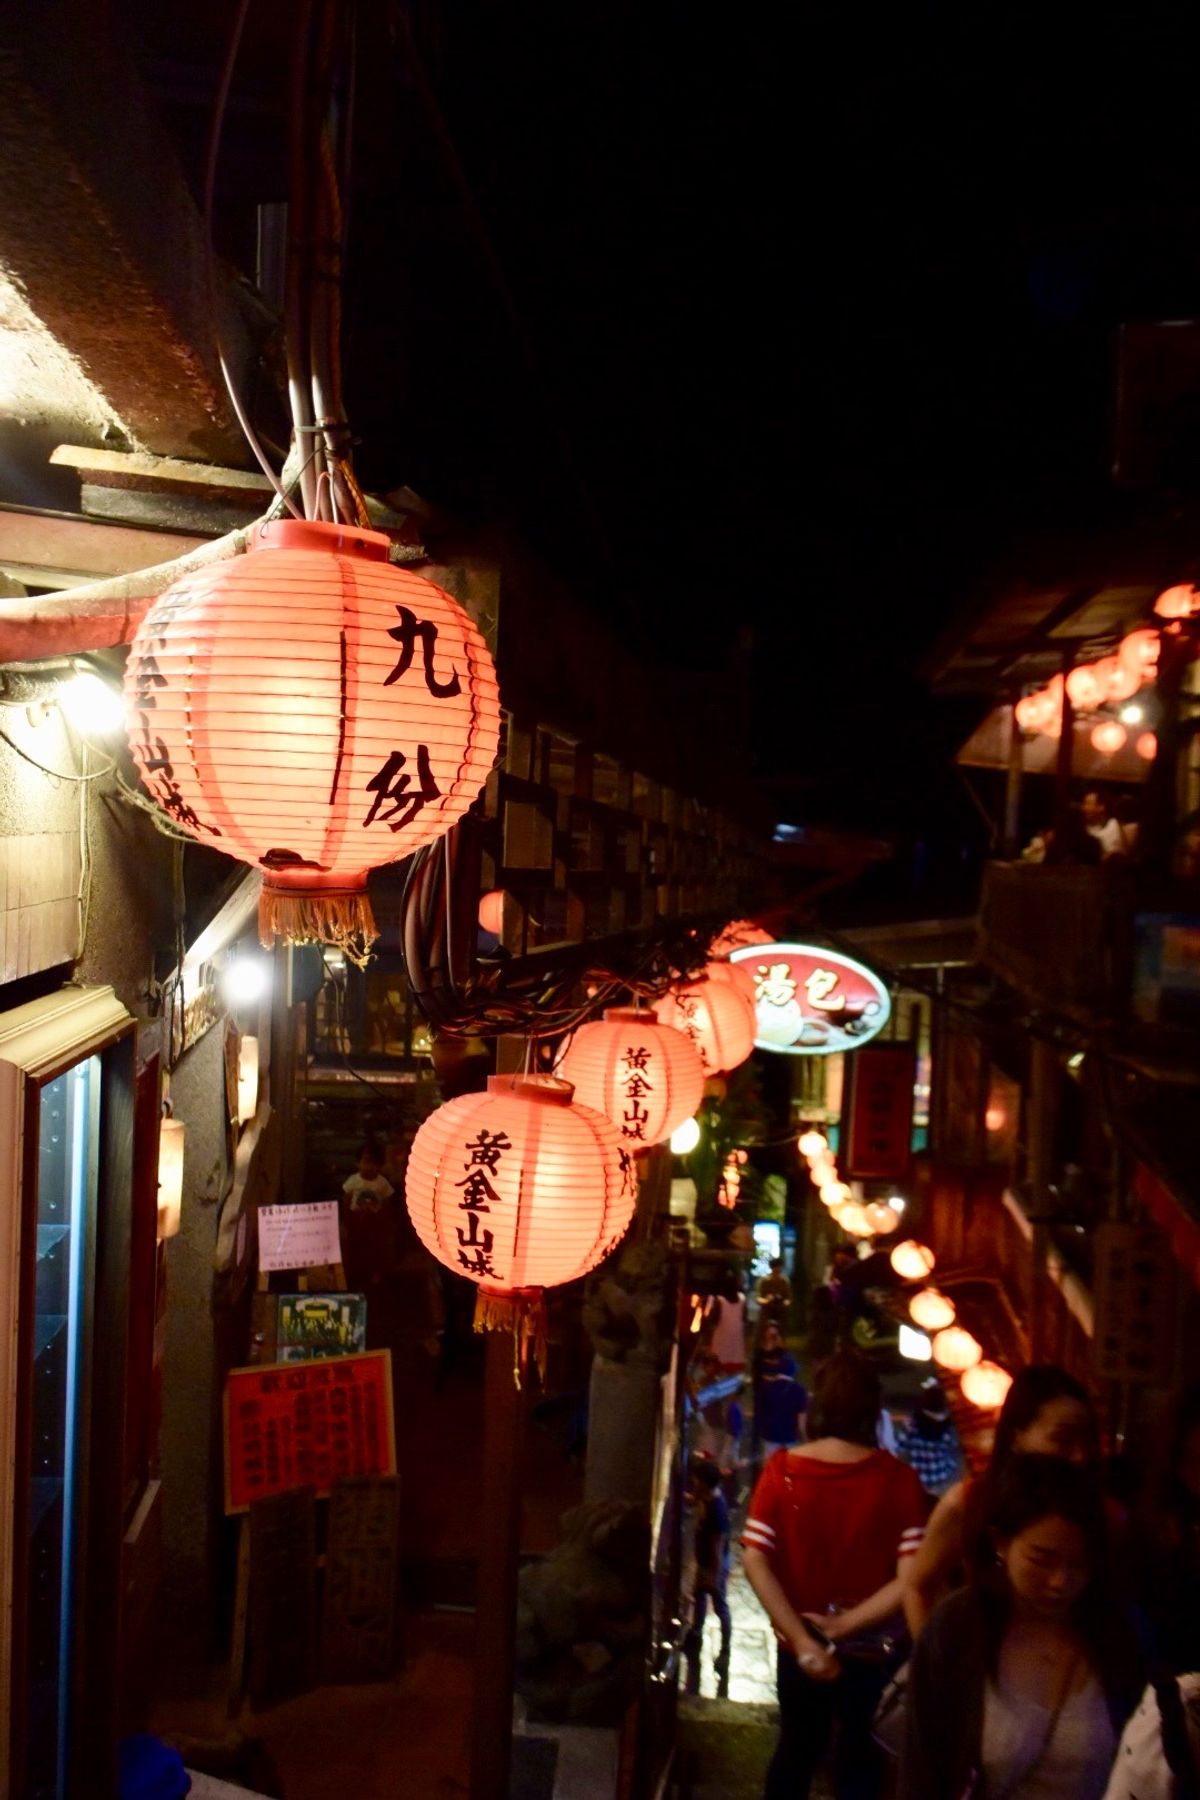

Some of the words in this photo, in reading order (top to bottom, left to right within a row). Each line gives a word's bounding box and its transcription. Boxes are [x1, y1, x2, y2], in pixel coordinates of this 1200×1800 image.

[363, 604, 461, 833] 九份
[752, 963, 846, 1012] 湯包
[620, 1046, 654, 1141] 黃金山城
[454, 1128, 512, 1280] 黃金山城
